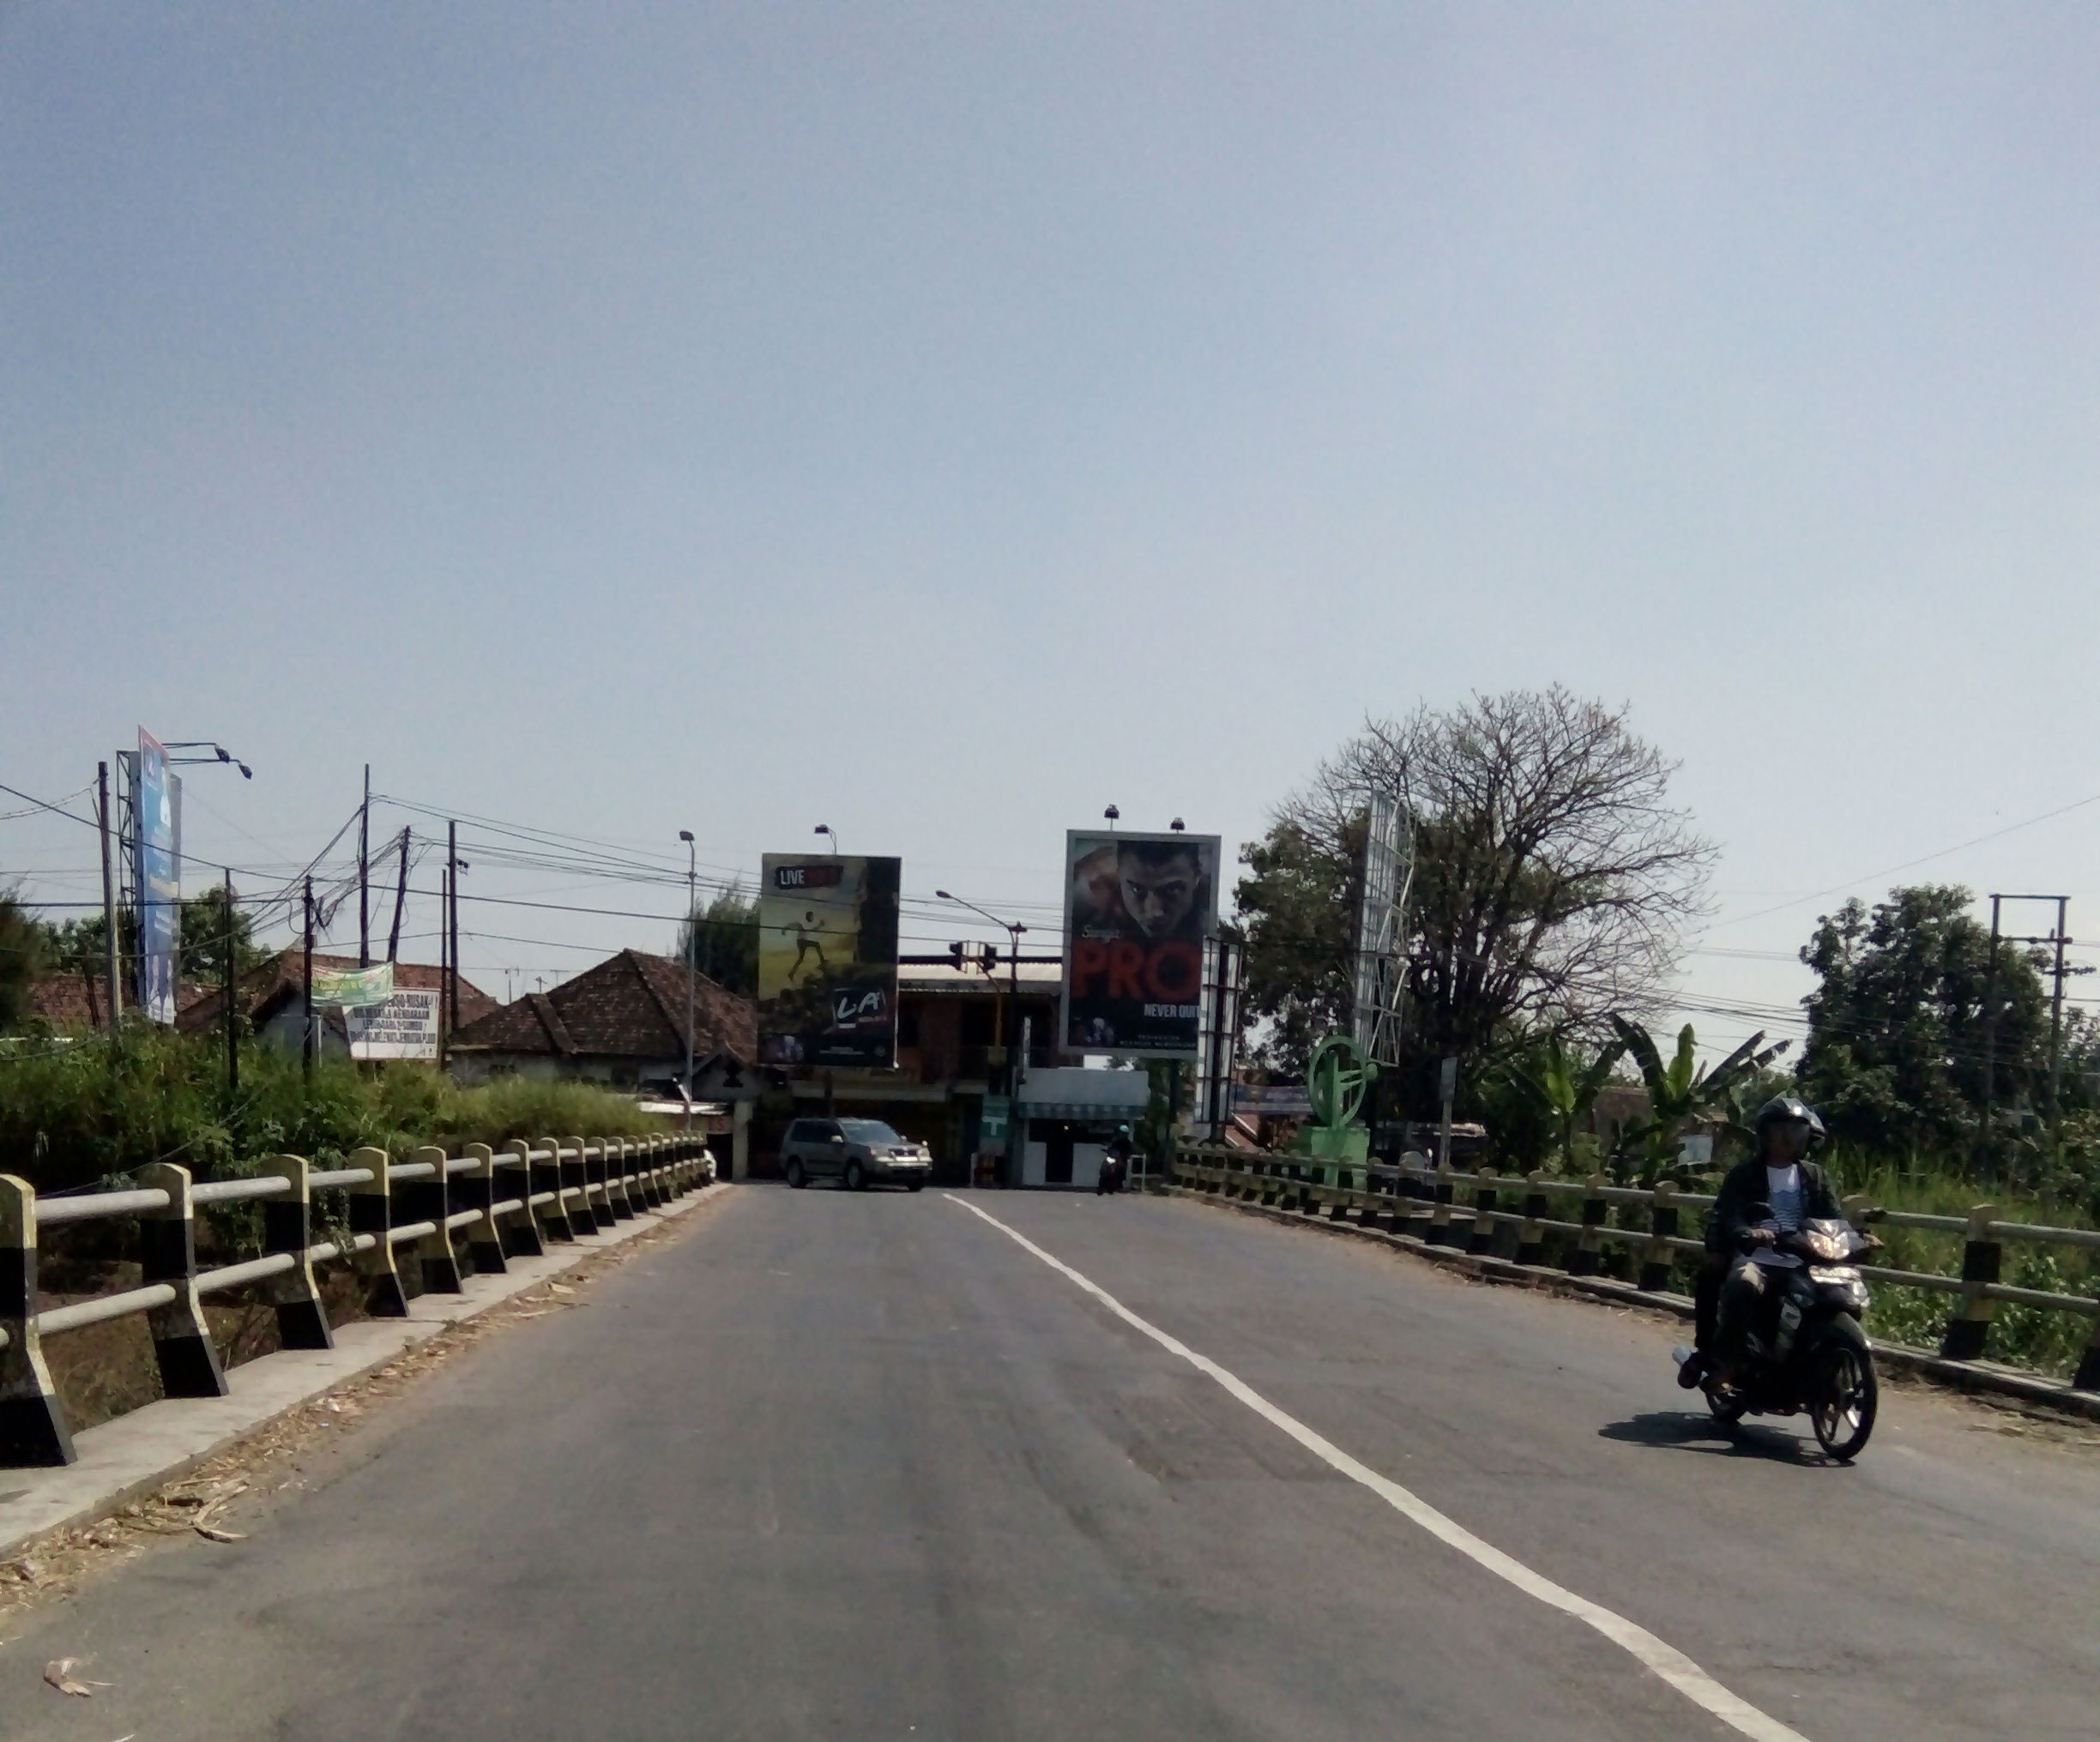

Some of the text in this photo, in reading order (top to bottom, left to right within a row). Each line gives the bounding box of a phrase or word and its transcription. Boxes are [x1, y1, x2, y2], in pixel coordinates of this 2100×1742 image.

[780, 869, 805, 885] LIVE
[1071, 938, 1201, 1001] PRO
[1144, 1004, 1176, 1017] NEVER
